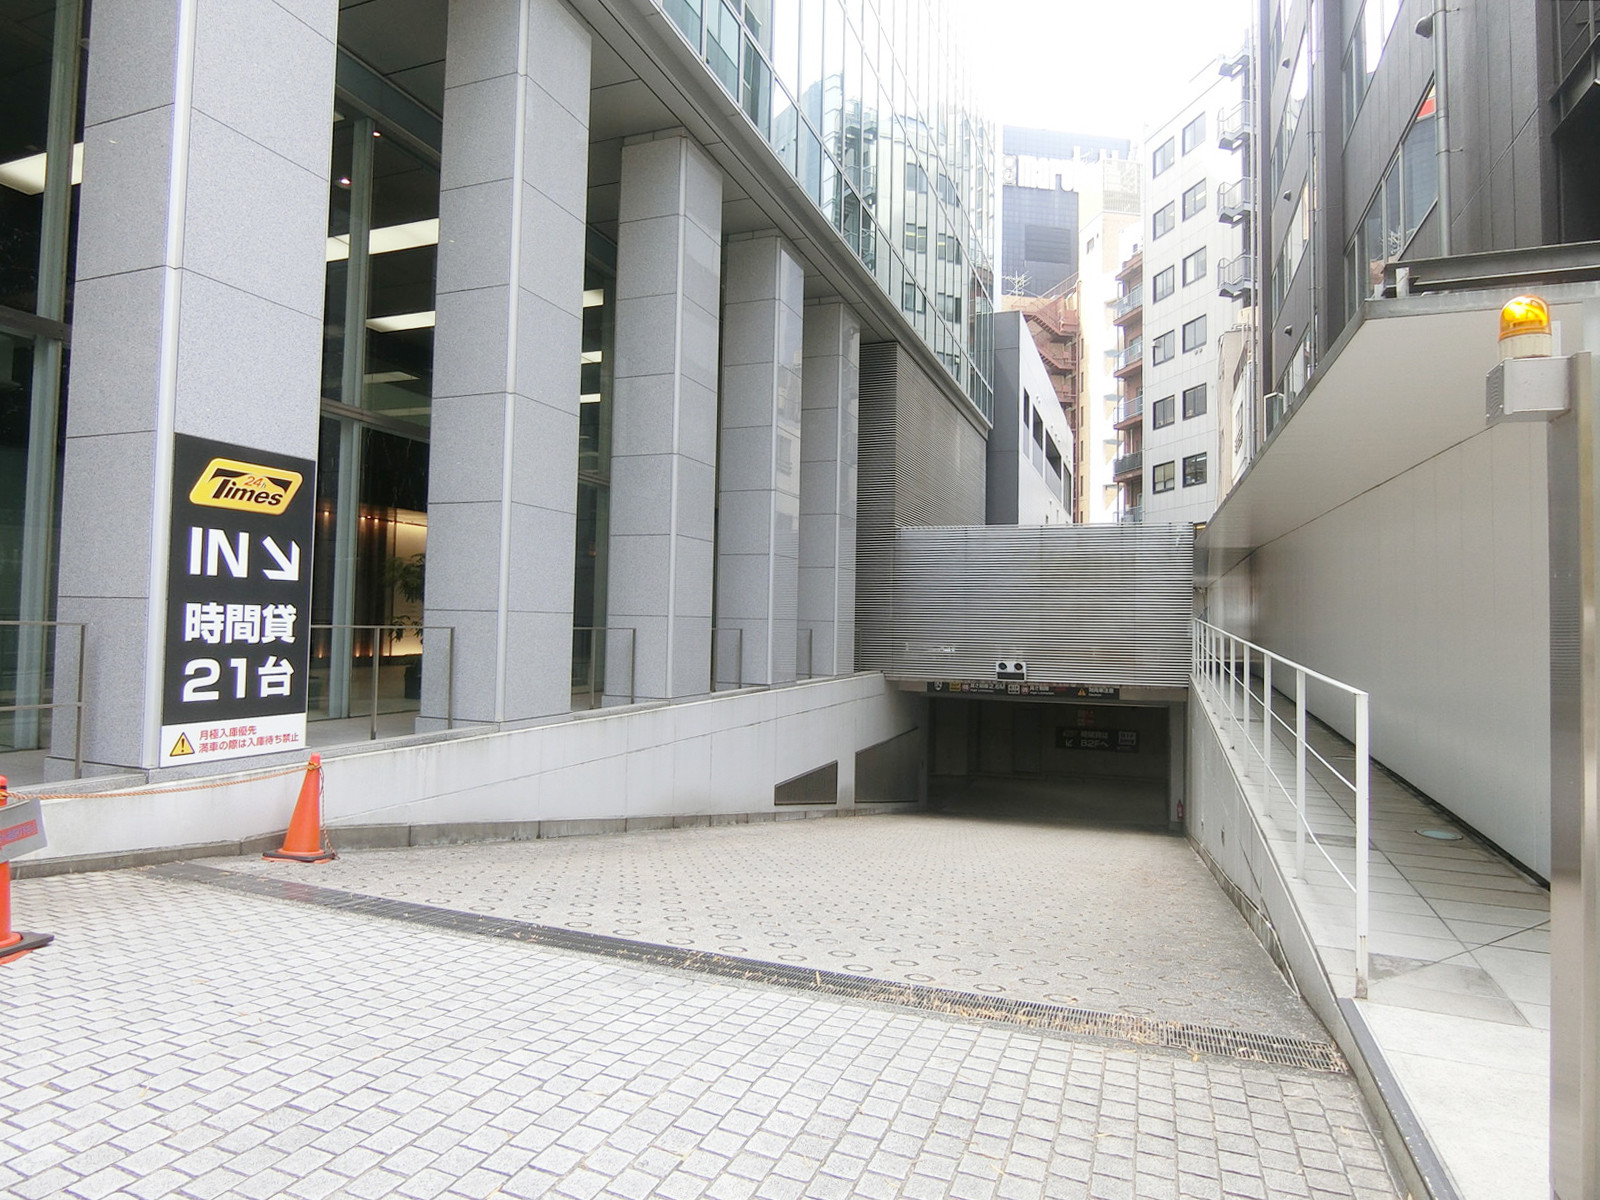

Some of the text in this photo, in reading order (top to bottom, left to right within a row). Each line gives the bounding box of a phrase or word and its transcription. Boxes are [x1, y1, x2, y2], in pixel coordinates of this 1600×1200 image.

[210, 470, 288, 506] Times
[189, 526, 250, 578] IN
[184, 602, 297, 644] 時間貸
[182, 656, 295, 703] 21台
[199, 733, 299, 753] 満車の際は入庫待ち禁止
[200, 725, 257, 740] 月極入庫優先
